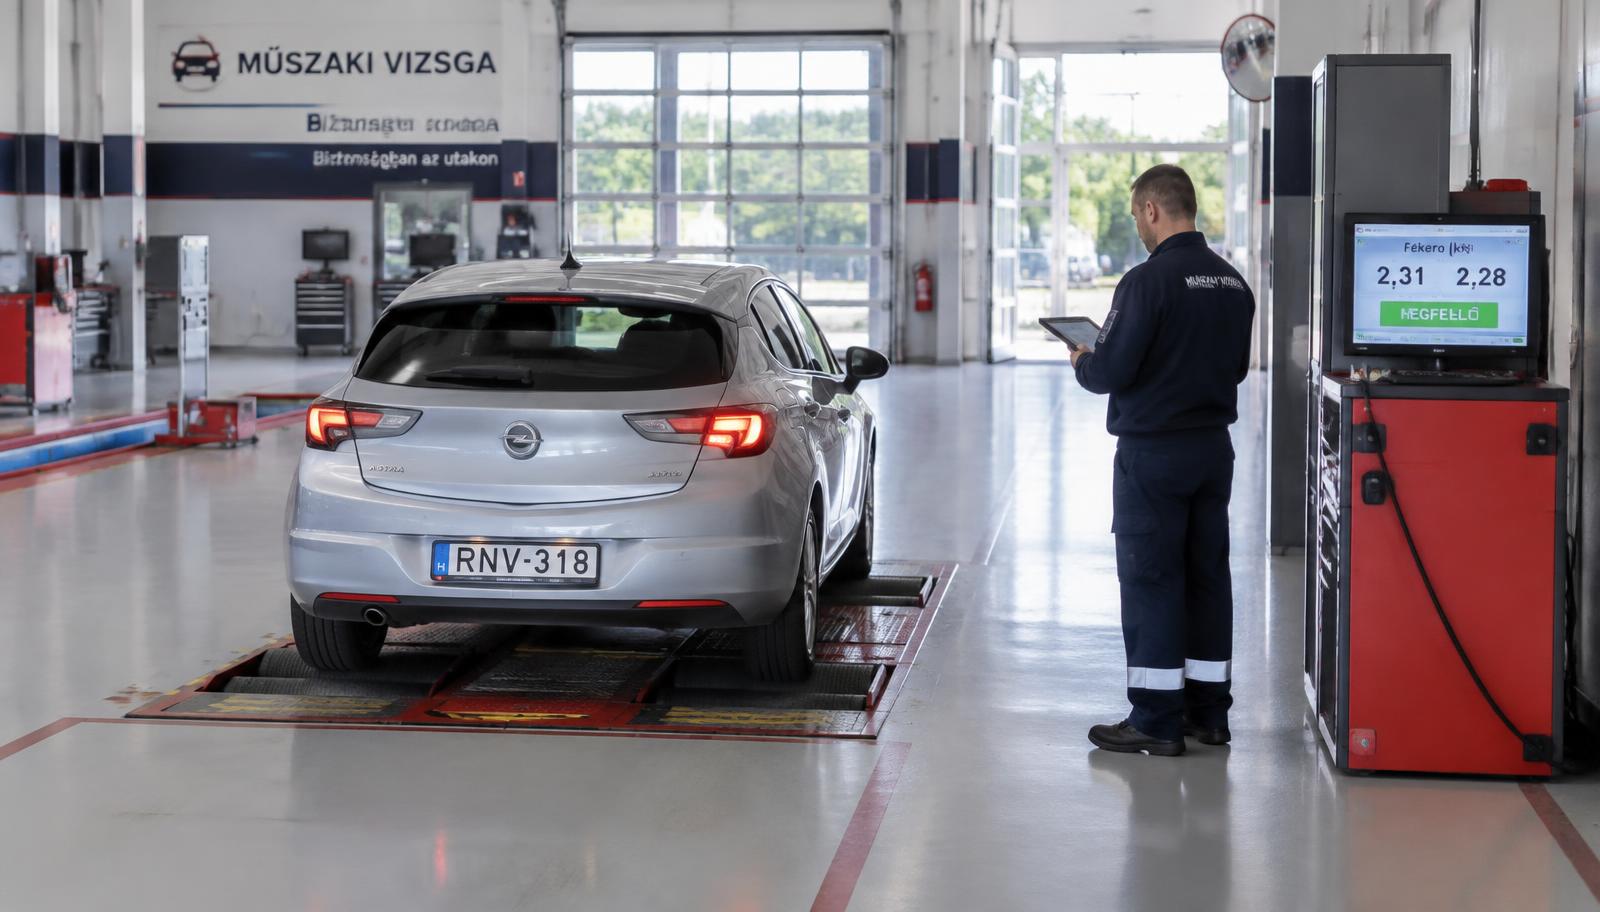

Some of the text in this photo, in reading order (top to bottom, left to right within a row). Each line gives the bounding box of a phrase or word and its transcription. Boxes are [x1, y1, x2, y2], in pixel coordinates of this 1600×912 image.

[237, 46, 497, 75] MŰSZAKI VIZSGA
[421, 154, 440, 166] az
[444, 151, 499, 166] utakon
[1376, 266, 1506, 290] 2,31 2,28
[437, 547, 589, 575] H RNV-318
